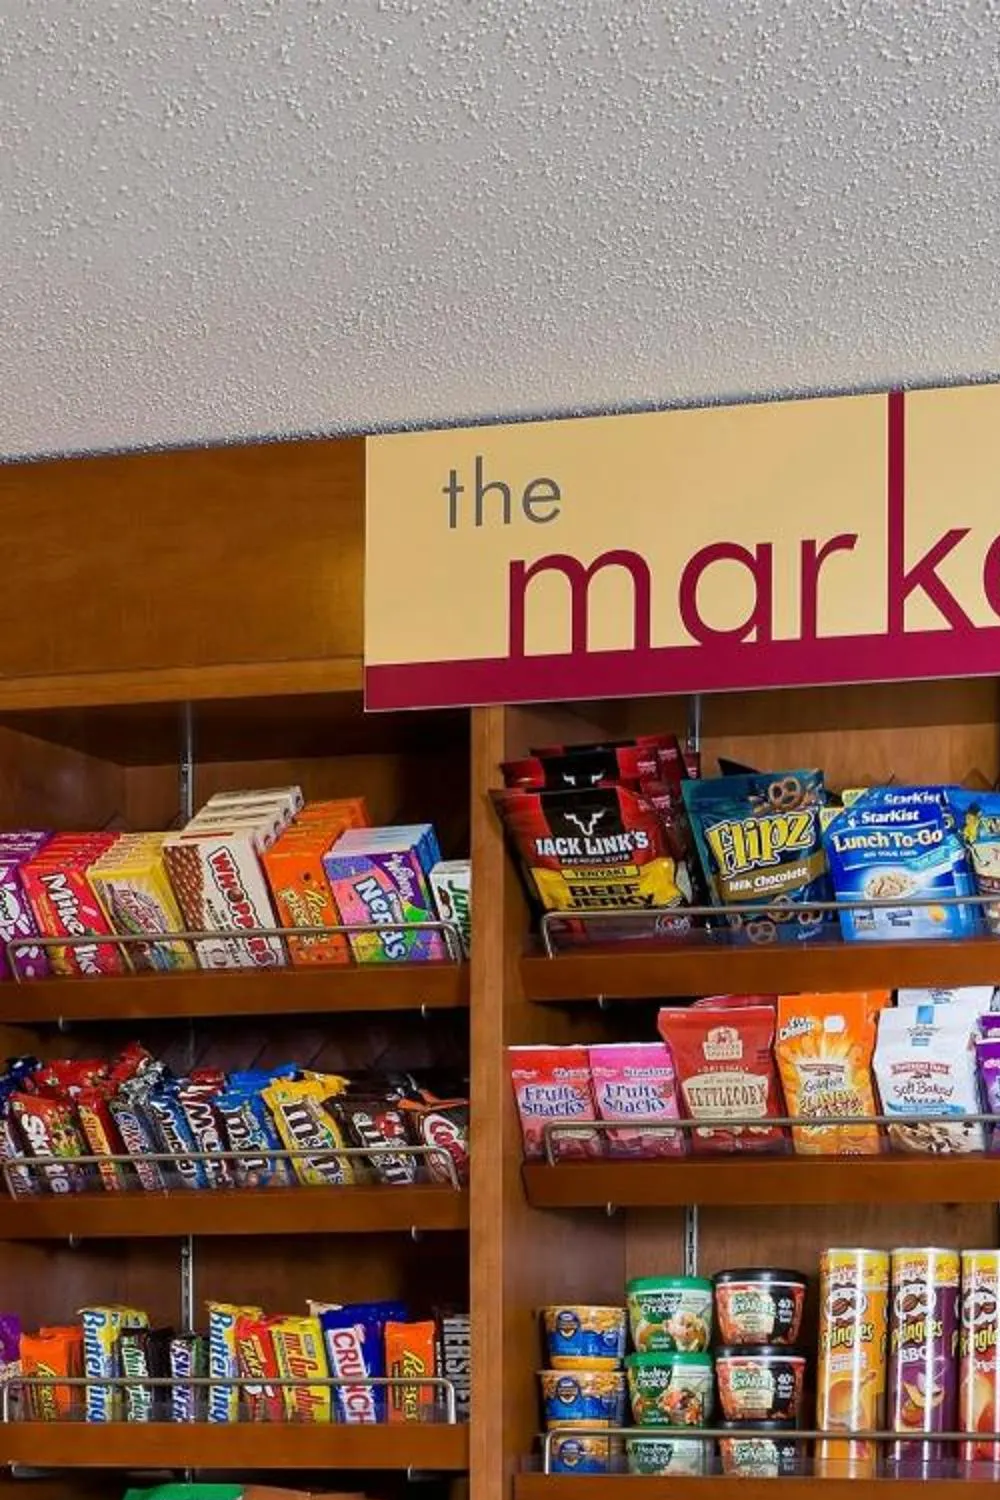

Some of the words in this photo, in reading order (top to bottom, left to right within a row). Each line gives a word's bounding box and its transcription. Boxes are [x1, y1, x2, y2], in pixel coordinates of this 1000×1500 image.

[442, 456, 562, 528] the
[862, 808, 920, 823] StarKist
[535, 837, 579, 856] JACK
[585, 830, 649, 856] LINK'S
[706, 812, 814, 877] Flipz
[832, 833, 889, 852] Lunch
[893, 828, 943, 847] To-Go
[568, 884, 641, 897] BEEF
[729, 879, 753, 892] Milk
[754, 867, 809, 887] Chocolate
[40, 873, 86, 936] Mike
[209, 848, 276, 965] WHOPPRS
[567, 894, 654, 910] JERKY
[353, 876, 407, 960] Nerds
[603, 1097, 667, 1114] Snacks
[892, 1084, 917, 1098] Soft
[521, 1098, 586, 1117] Snacks
[821, 1322, 875, 1351] Pringes
[891, 1320, 944, 1351] Pringes
[83, 1311, 109, 1423] Buttering
[211, 1311, 235, 1423] Buttering
[332, 1332, 372, 1424] CRUNCH
